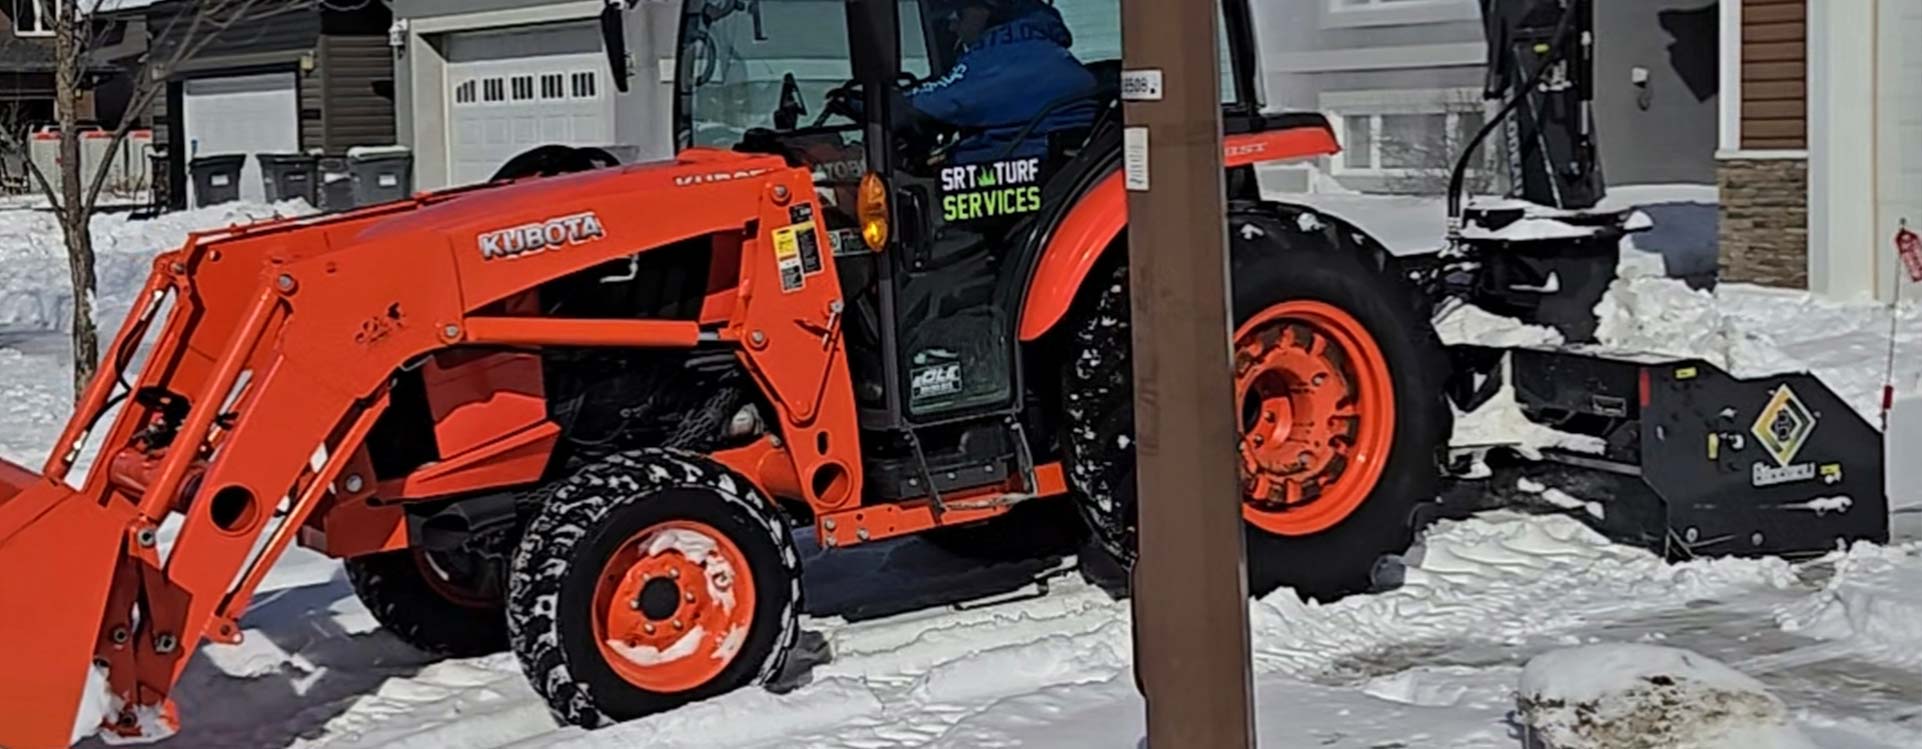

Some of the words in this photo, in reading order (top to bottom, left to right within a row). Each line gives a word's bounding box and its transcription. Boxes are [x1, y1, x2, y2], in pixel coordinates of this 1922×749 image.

[941, 165, 977, 191] SRT
[993, 158, 1039, 185] TURF
[943, 186, 1041, 221] SERVICES
[480, 213, 604, 259] KUBOTA
